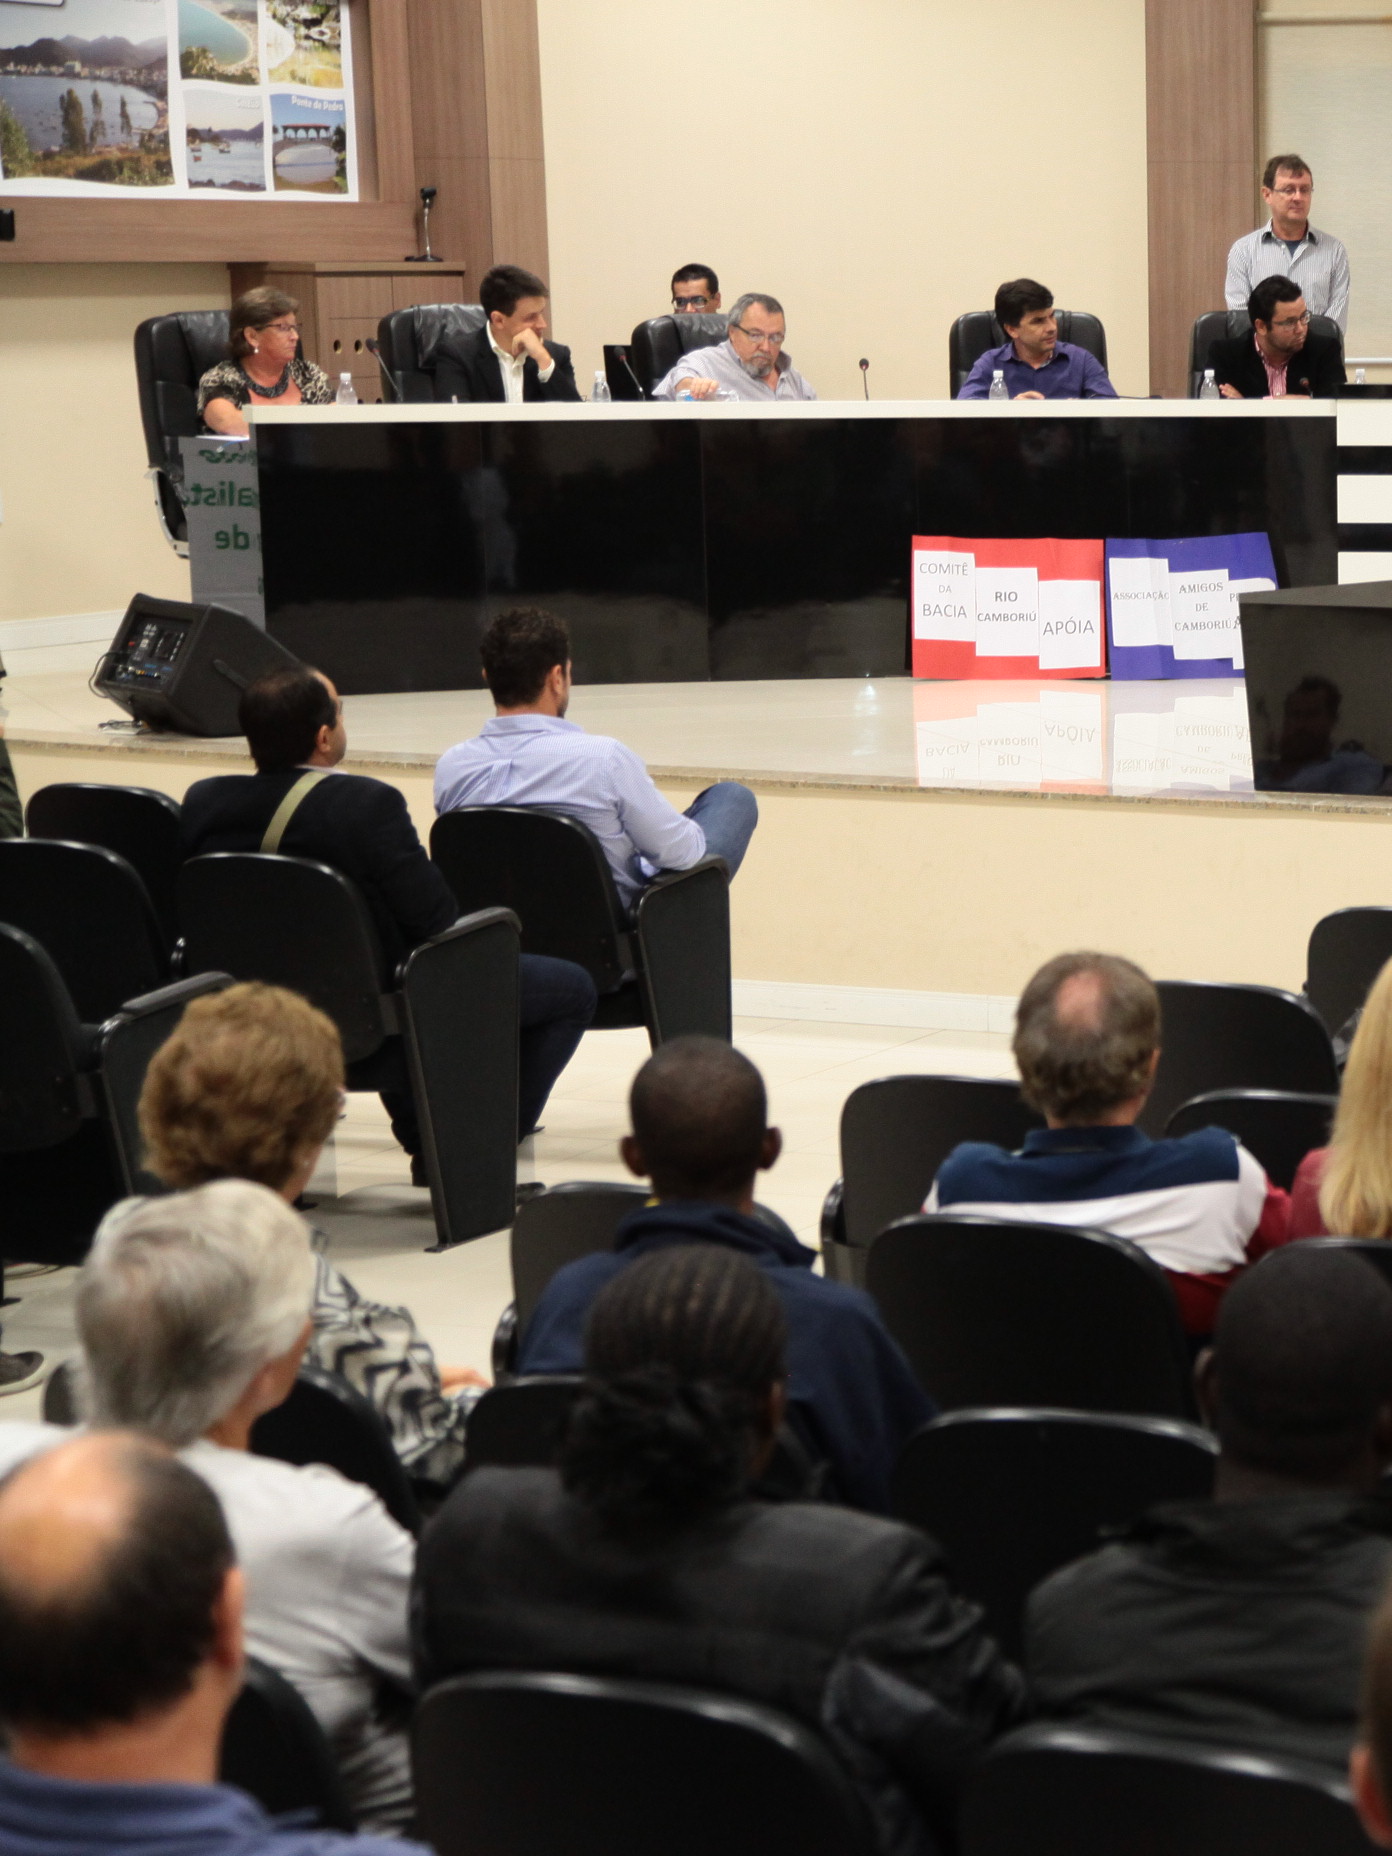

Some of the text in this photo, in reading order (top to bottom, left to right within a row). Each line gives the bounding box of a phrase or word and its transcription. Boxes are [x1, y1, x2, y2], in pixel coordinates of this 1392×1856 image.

[919, 562, 969, 577] COMITÊ
[938, 584, 953, 594] DA
[1178, 581, 1225, 595] AMIGOS
[994, 591, 1019, 603] RIO
[922, 603, 968, 619] BACIA
[1195, 602, 1210, 612] DE
[977, 610, 1038, 622] CAMBORIÚ
[1042, 616, 1096, 636] APÓIA
[1174, 617, 1232, 632] CAMBORIÚ
